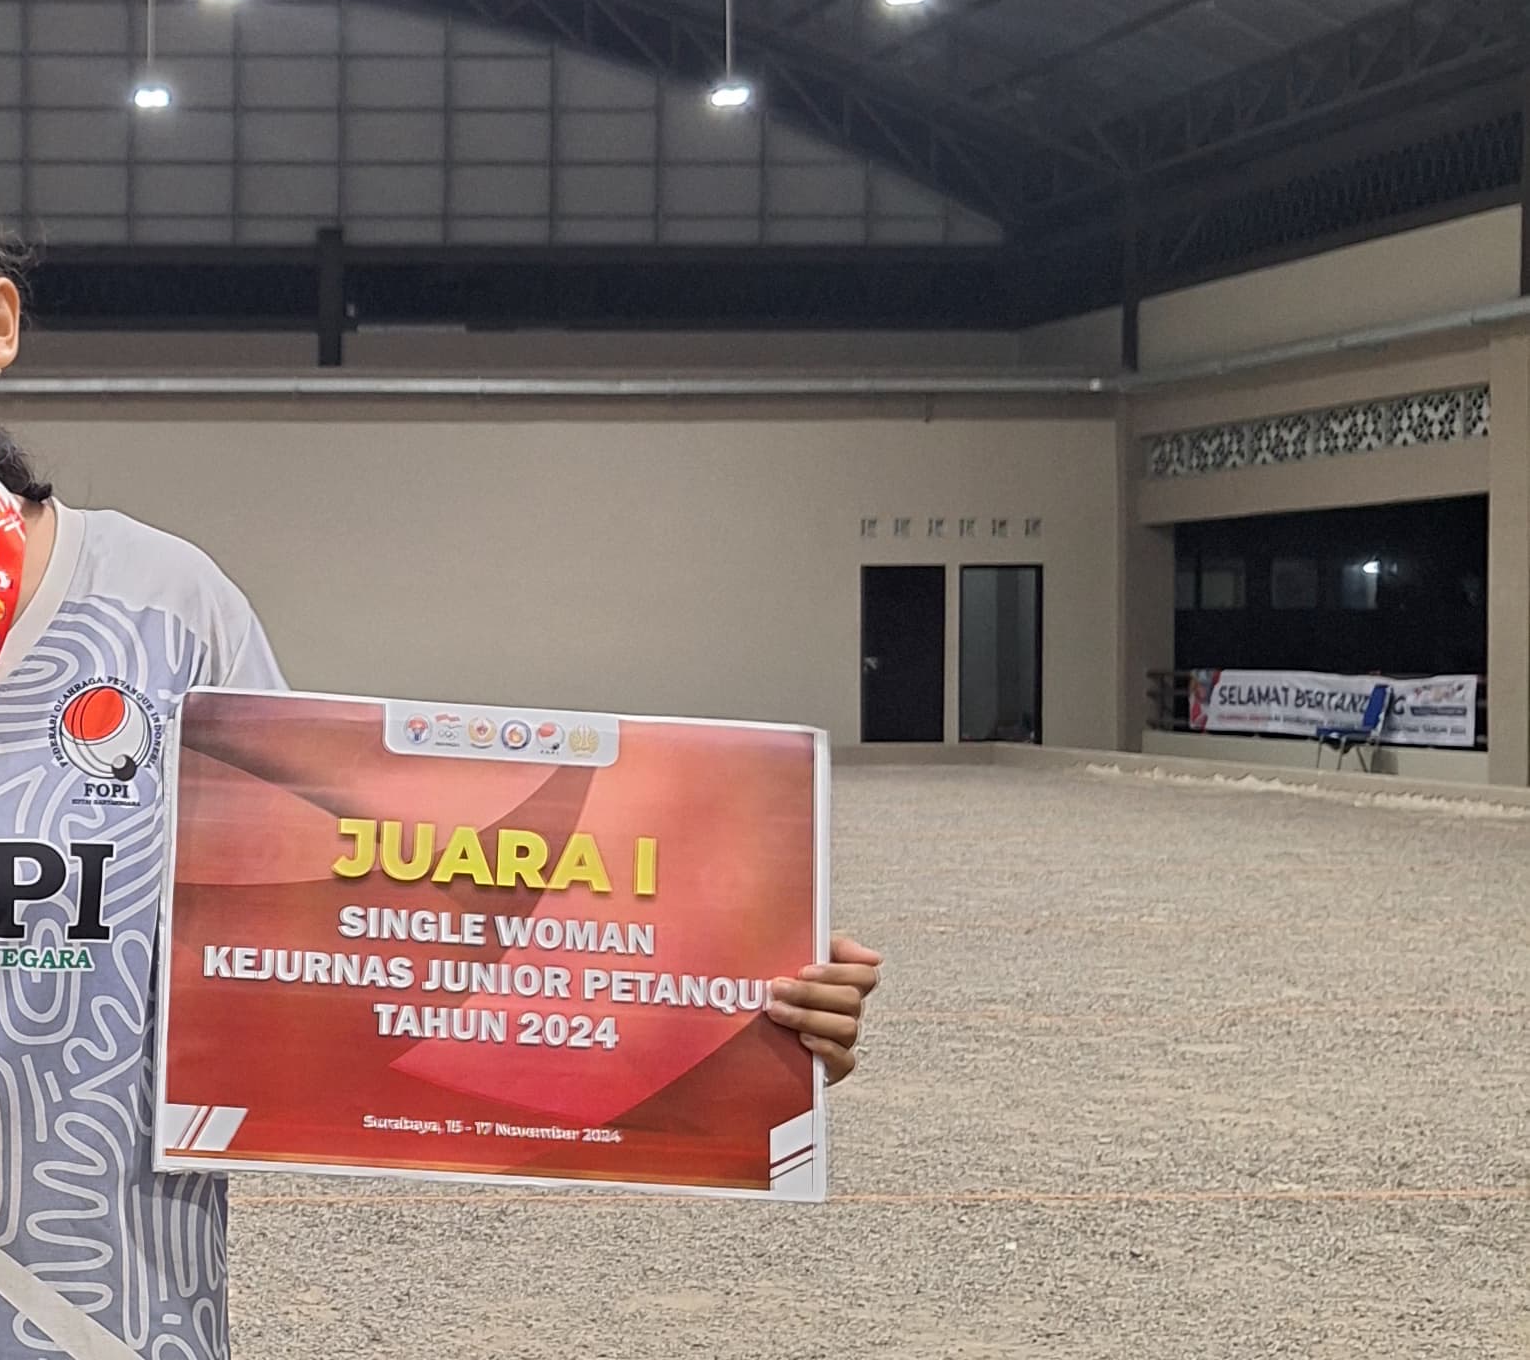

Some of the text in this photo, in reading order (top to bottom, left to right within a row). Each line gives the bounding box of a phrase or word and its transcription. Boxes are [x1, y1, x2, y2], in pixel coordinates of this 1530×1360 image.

[54, 676, 104, 713] OLAHRAGA
[1219, 685, 1290, 707] SELAMAT
[83, 782, 130, 799] FOPI
[332, 817, 657, 895] JUARA I
[338, 905, 655, 956] SINGLE WOMAN
[203, 945, 414, 989] KEJURNAS
[421, 959, 571, 999] JUNIOR
[374, 1003, 619, 1050] TAHUN 2024
[363, 1115, 442, 1135] Surabaya,
[445, 1119, 464, 1134] 15
[474, 1121, 493, 1136] 17
[495, 1122, 580, 1141] November
[581, 1128, 623, 1143] 2024
